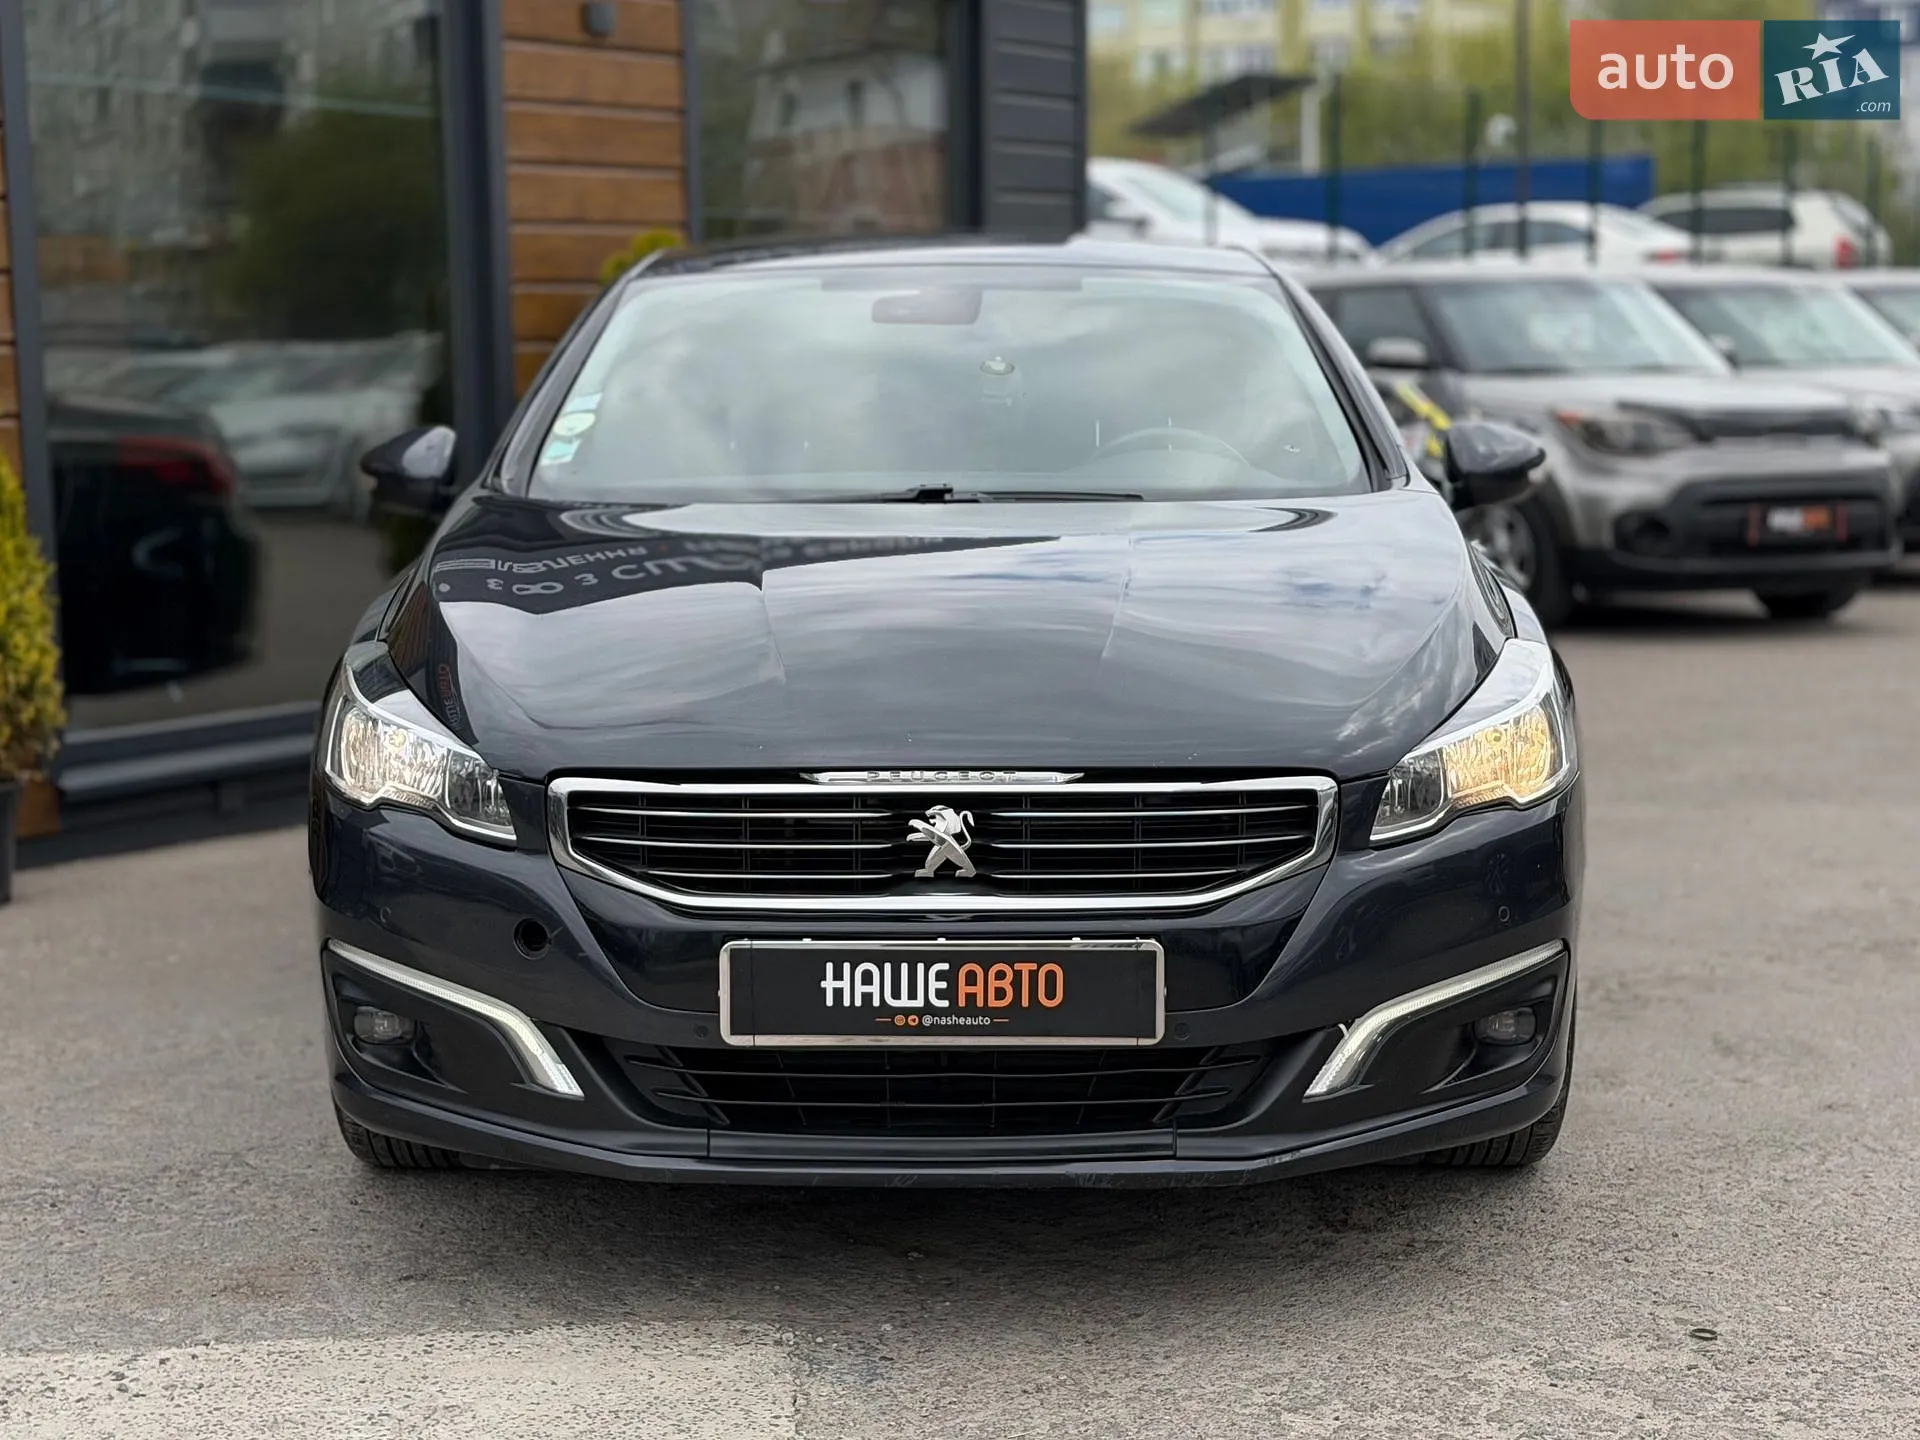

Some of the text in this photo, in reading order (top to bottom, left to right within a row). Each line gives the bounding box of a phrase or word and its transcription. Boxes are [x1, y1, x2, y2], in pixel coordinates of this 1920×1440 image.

[866, 770, 1016, 782] PEUGEOT
[820, 961, 1064, 1008] НАШЕ АВТО
[922, 1014, 991, 1026] @nasheauto
